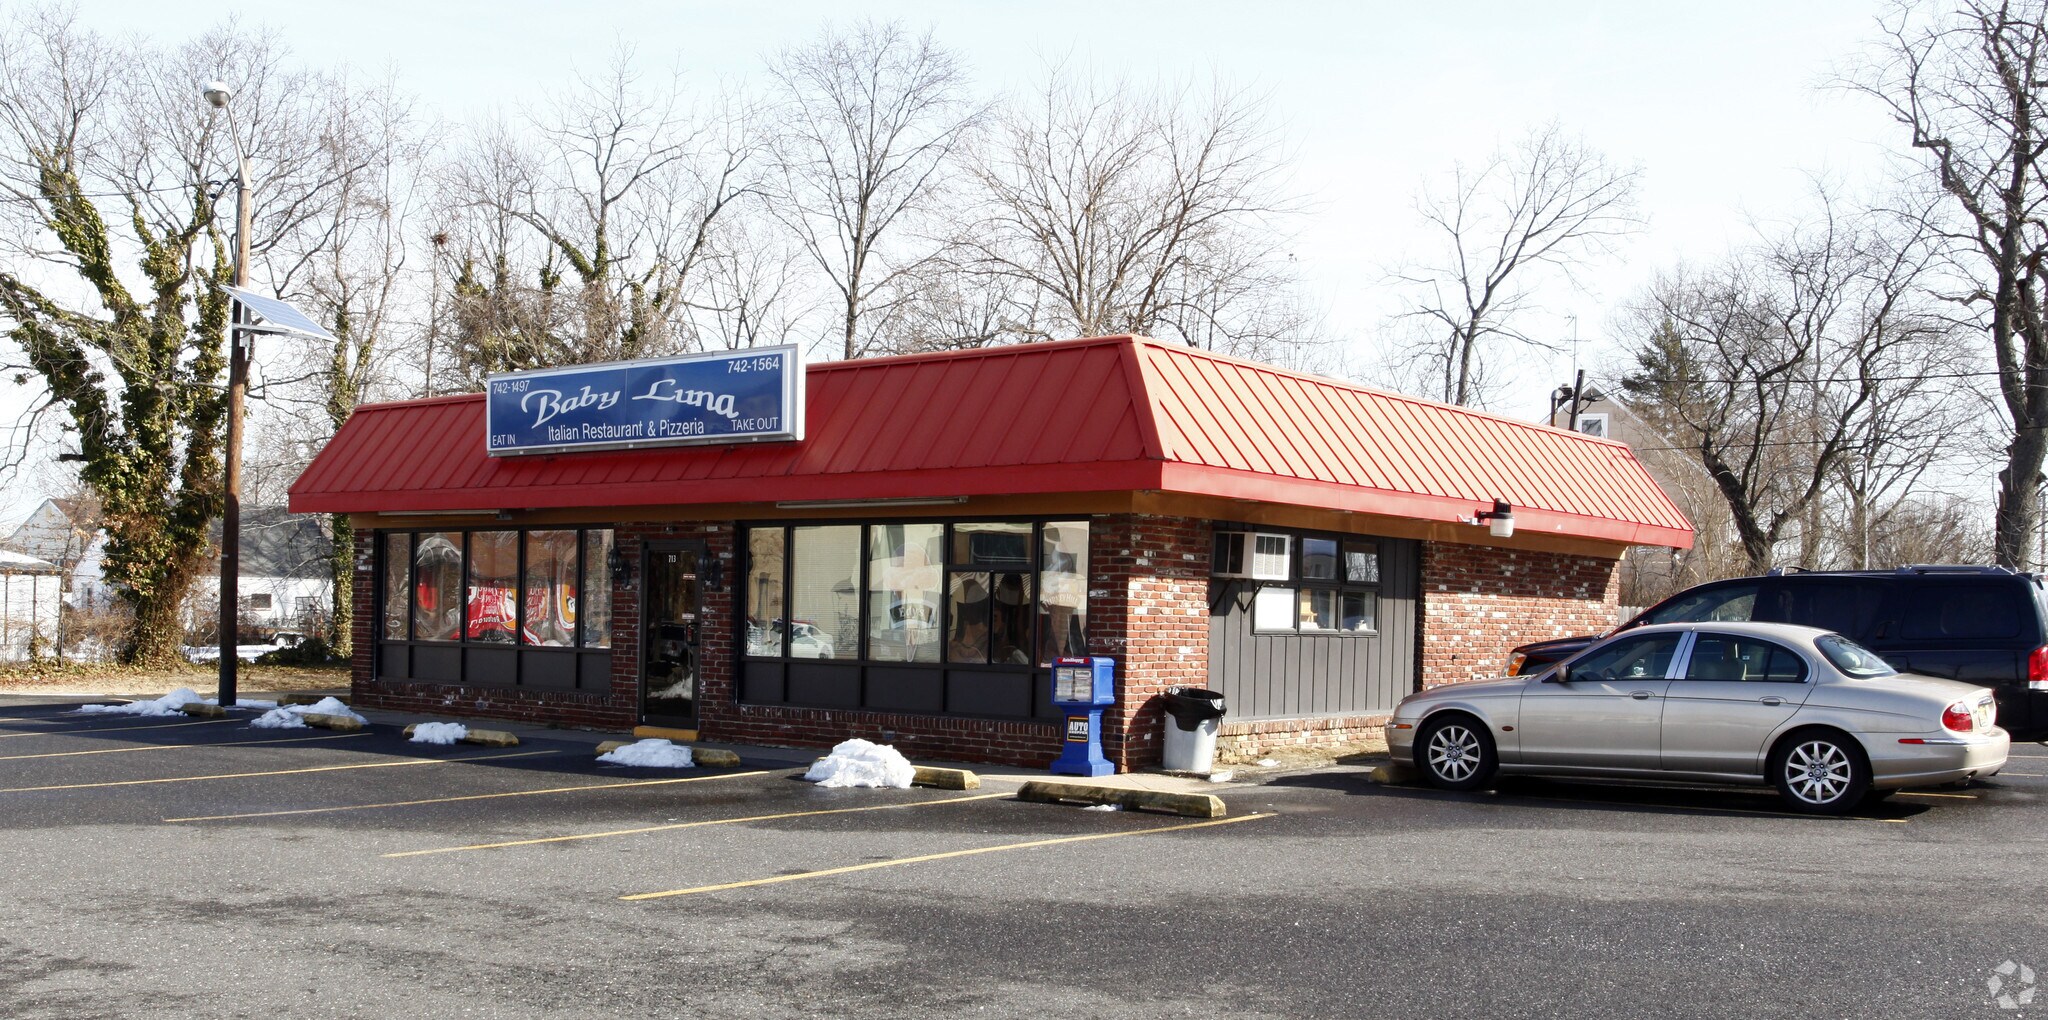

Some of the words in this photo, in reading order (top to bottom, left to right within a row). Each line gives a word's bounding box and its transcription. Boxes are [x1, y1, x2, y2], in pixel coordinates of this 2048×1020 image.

[727, 356, 780, 374] 742-1564
[493, 380, 530, 394] 742-1497
[521, 385, 621, 429] Baby
[632, 378, 739, 418] Luna
[548, 425, 580, 441] Italian
[582, 419, 643, 438] Restaurant
[647, 420, 656, 437] &
[659, 418, 705, 435] Pizzeria
[731, 419, 756, 431] TAKE
[757, 417, 779, 430] OUT
[492, 435, 506, 446] EAT
[507, 434, 516, 445] IN
[668, 554, 677, 563] 713
[1069, 721, 1088, 731] AUTO
